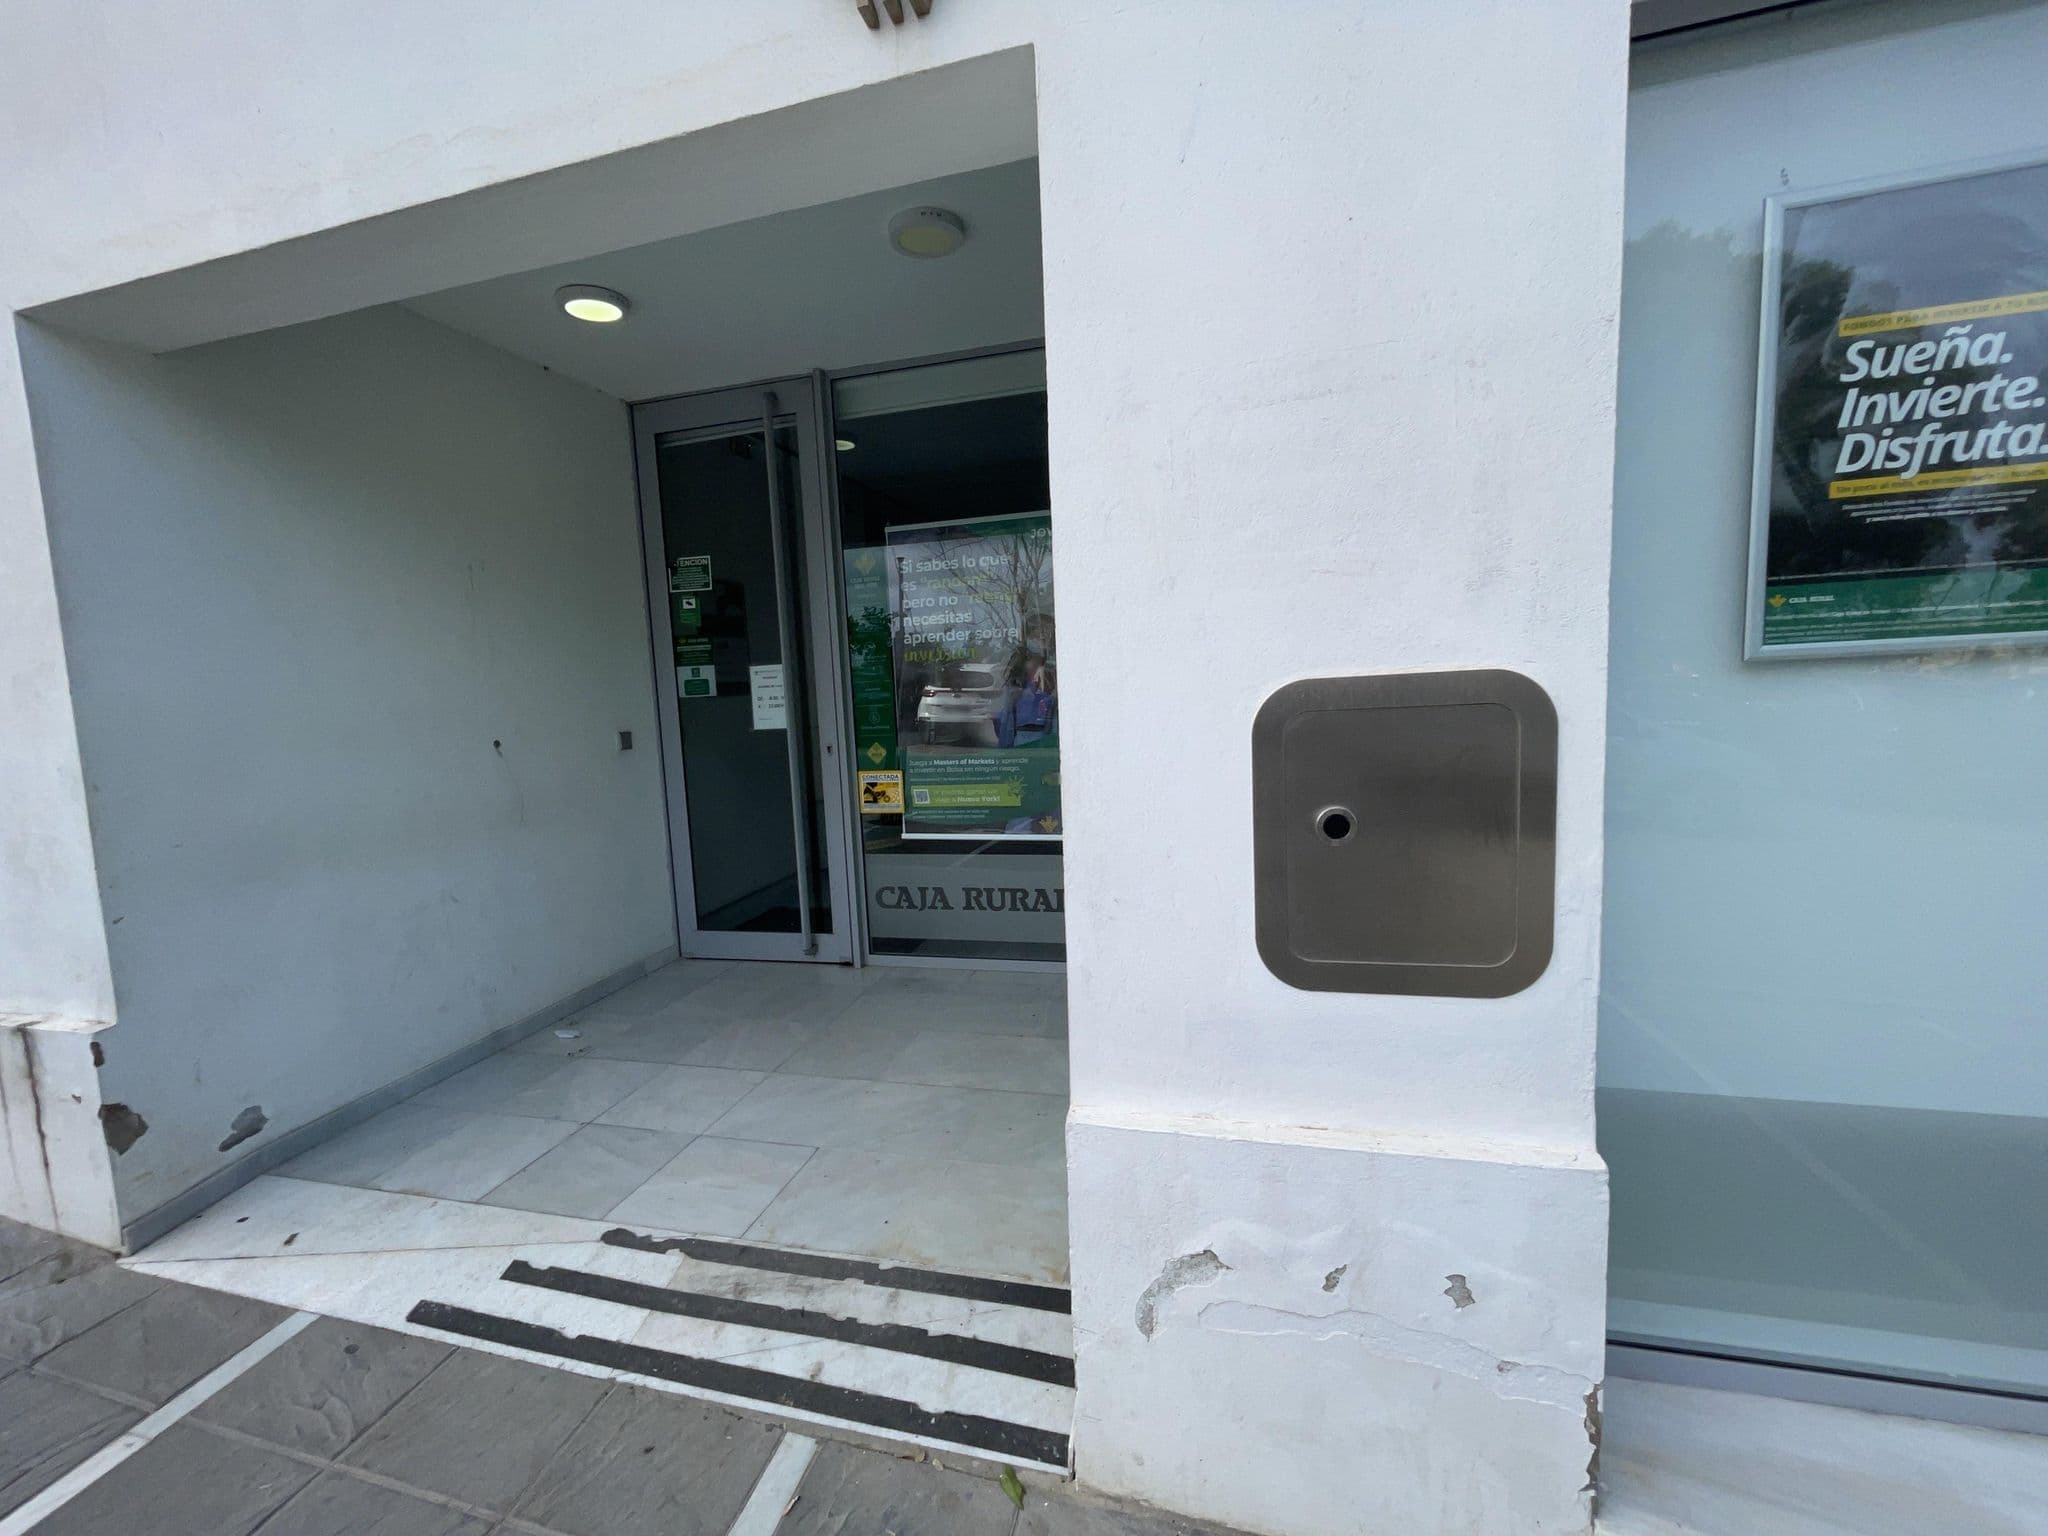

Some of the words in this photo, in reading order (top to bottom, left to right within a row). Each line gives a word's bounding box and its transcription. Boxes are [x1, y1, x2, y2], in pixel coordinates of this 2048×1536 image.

[1839, 323, 2014, 383] Sueña.
[1837, 372, 2046, 429] Invierte.
[1834, 420, 2048, 480] Disfruta.
[900, 559, 912, 574] Si
[916, 556, 959, 573] sabes
[962, 554, 976, 568] lo
[979, 554, 1008, 570] que
[902, 580, 917, 592] es
[902, 595, 935, 610] pero
[938, 594, 958, 607] no
[903, 610, 972, 627] necesitas
[903, 628, 975, 648] aprender
[975, 626, 1017, 641] sobre
[933, 758, 959, 766] Masters
[968, 757, 995, 766] Markets
[875, 886, 954, 912] CAJA
